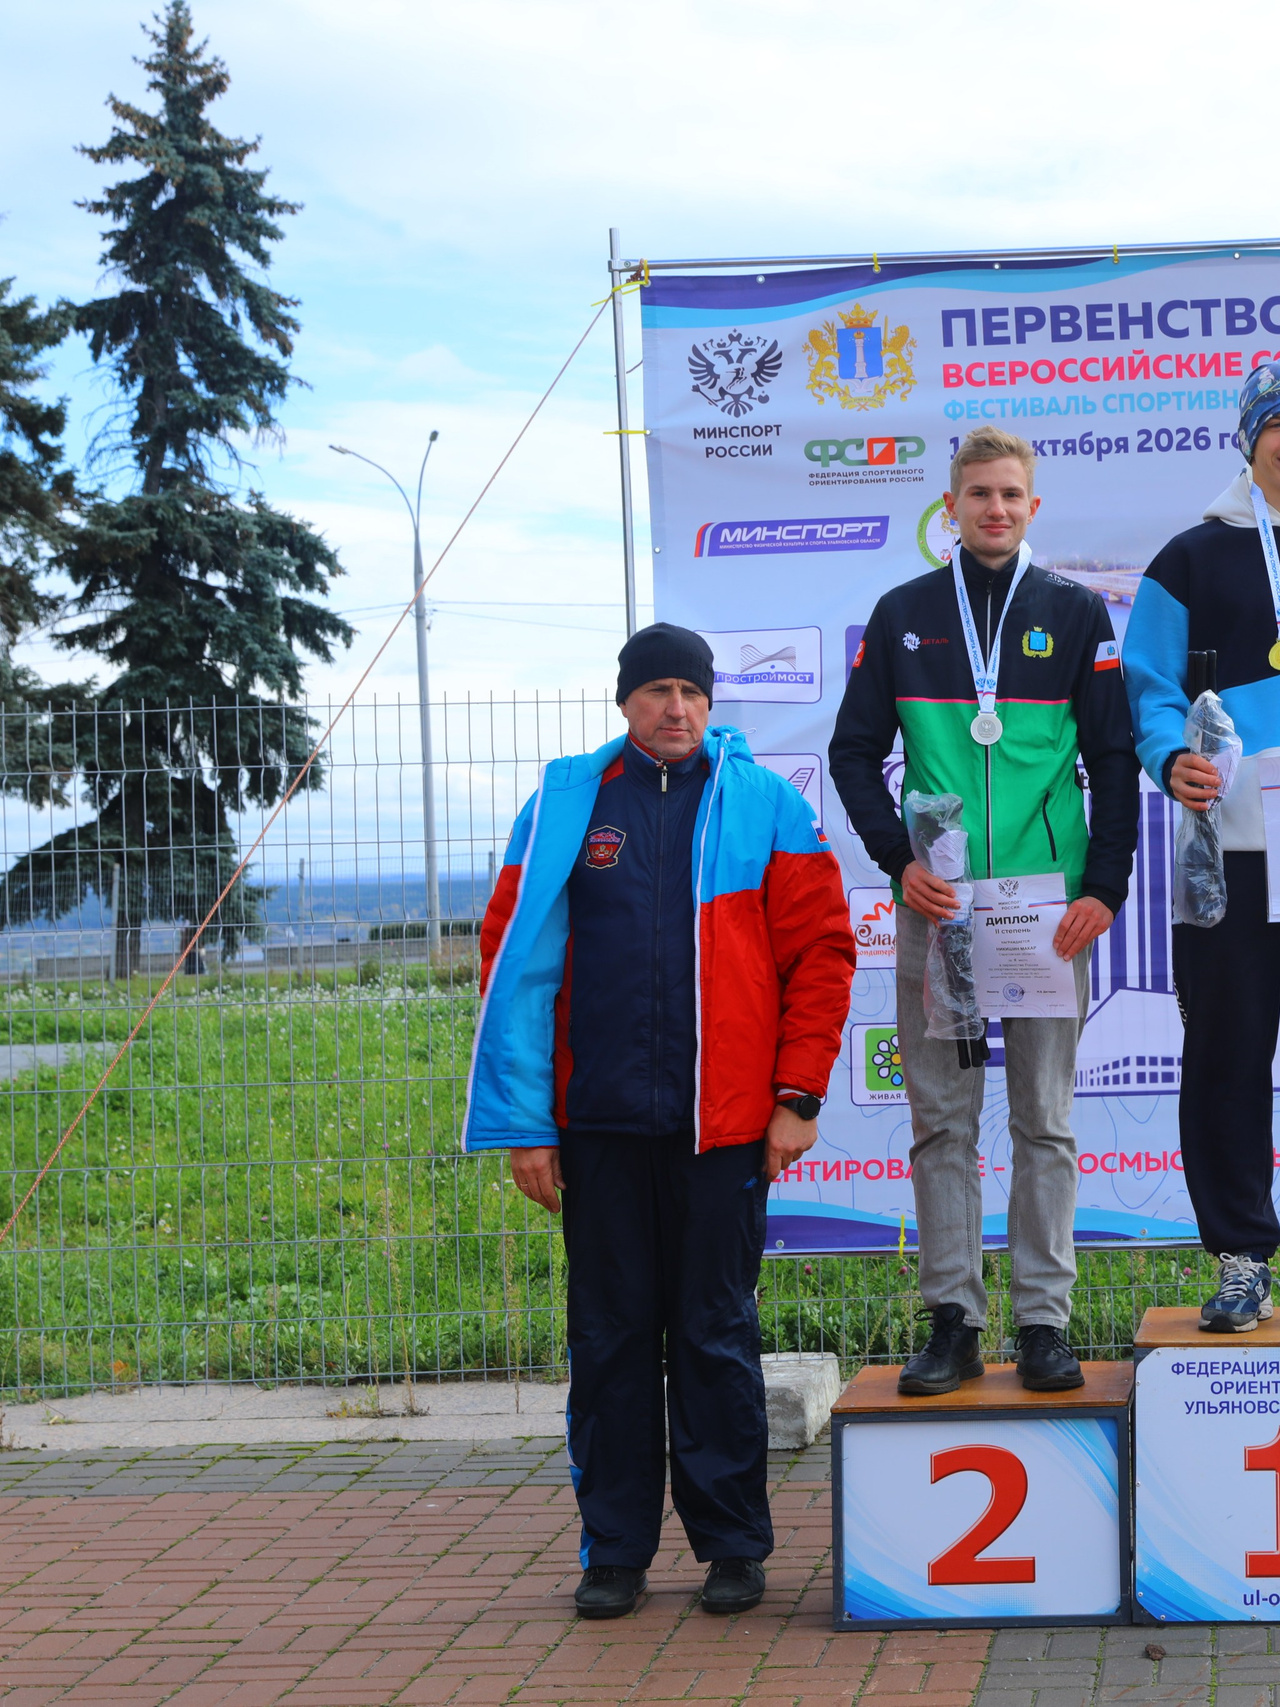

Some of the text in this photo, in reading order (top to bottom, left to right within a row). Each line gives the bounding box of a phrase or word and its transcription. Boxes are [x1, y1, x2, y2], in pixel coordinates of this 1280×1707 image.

[942, 349, 1243, 388] ВСЕРОССИЙСКИЕ
[943, 395, 1097, 421] ФЕСТИВАЛЬ
[693, 424, 782, 440] МИНСПОРТ
[705, 444, 773, 458] РОССИИ
[1032, 431, 1129, 461] ктября
[1137, 427, 1211, 452] 2026
[809, 468, 924, 479] ФЕДЕРАЦИЯ СПОРТИВНОГО
[809, 477, 887, 486] ОРИЕНТИРОВАНИЯ
[720, 522, 881, 543] МИНСПОРТ
[986, 914, 1040, 927] ДИПЛОМ
[1171, 1361, 1280, 1377] ФЕДЕРАЦИЯ
[928, 1443, 1036, 1585] 2
